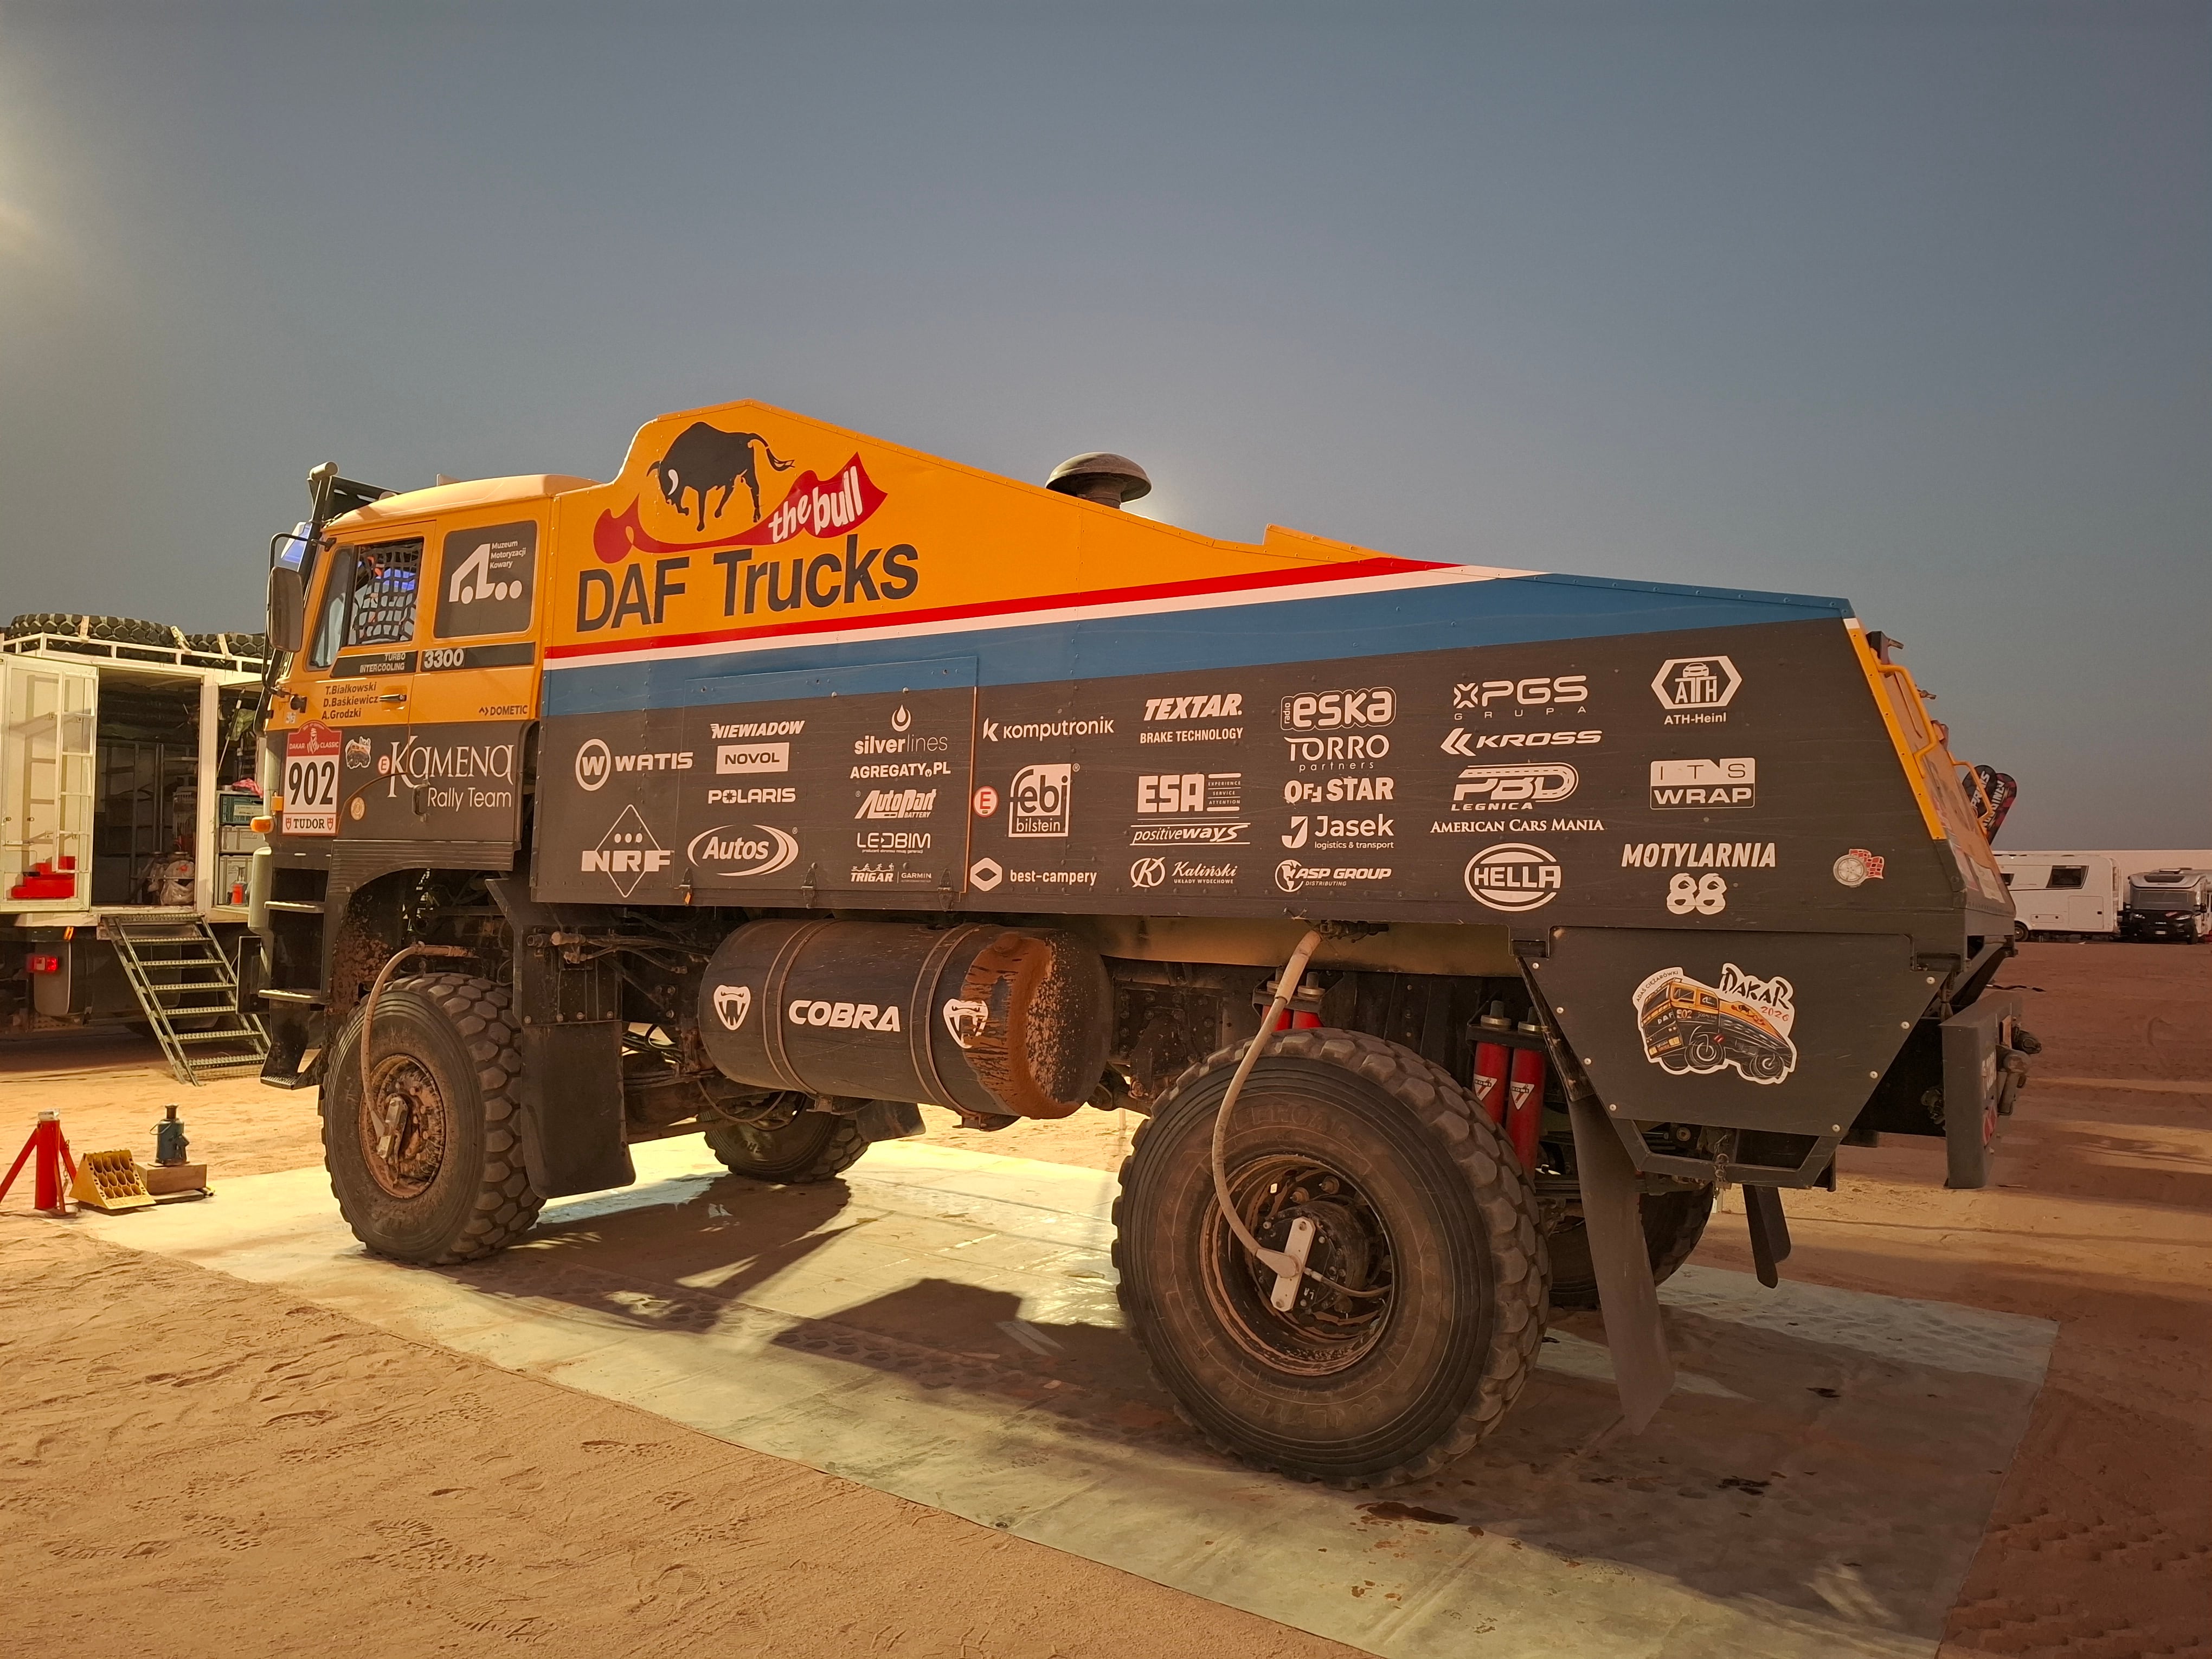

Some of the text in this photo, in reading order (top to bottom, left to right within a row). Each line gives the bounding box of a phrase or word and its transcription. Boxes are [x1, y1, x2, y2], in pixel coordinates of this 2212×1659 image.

[768, 466, 863, 543] the bull
[491, 548, 526, 559] Motoryzacji
[492, 541, 518, 550] Muzeum
[490, 560, 512, 569] Kowary
[576, 533, 918, 633] DAF Trucks
[384, 653, 406, 661] TURBO
[423, 649, 464, 668] 3300
[359, 663, 404, 673] INTERCOOLING
[325, 682, 376, 695] T.Białkowski
[1675, 676, 1717, 704] ATH
[321, 709, 361, 719] A.Grodzki
[490, 705, 528, 716] DOMETIC
[1454, 706, 1586, 720] GRUPA
[1664, 712, 1726, 725] ATH-Heinl
[1003, 716, 1114, 741] komputronik
[1140, 728, 1244, 744] BRAKE TECHNOLOGY
[854, 734, 948, 755] silverlines
[1284, 734, 1390, 761] TORRO
[1476, 730, 1603, 749] KROSS
[615, 752, 693, 771] WATIS
[725, 752, 780, 764] NOVOL
[850, 762, 951, 779] AGREGATY.PL
[1299, 761, 1374, 773] partners
[1660, 763, 1745, 780] ITS
[288, 761, 335, 806] 902
[1326, 777, 1394, 802] STAR
[1453, 763, 1577, 801] PBD
[427, 787, 511, 812] Rally Team
[708, 788, 796, 803] POLARIS
[1009, 769, 1068, 814] febi
[1138, 774, 1205, 812] ESA
[1653, 787, 1752, 805] WRAP
[854, 789, 937, 819] AutoPart
[980, 792, 991, 809] E
[1451, 802, 1533, 811] LEGNICA
[294, 818, 325, 829] TUDOR
[1017, 817, 1060, 832] bilstein
[1315, 813, 1394, 837] Jasek
[857, 832, 931, 848] LEDBIM
[1133, 824, 1248, 843] positiveways
[702, 836, 769, 859] Autos
[1315, 841, 1347, 850] logistics
[1356, 841, 1394, 850] transport
[581, 850, 671, 872] NRF
[1621, 843, 1776, 867] MOTYLARNIA
[851, 872, 893, 882] TRIGAR
[1011, 869, 1097, 886] best-campery
[1172, 861, 1238, 877] Kaliński
[1333, 868, 1392, 879] GROUP
[1474, 865, 1561, 889] HELLA
[1667, 872, 1727, 915] 88
[1722, 967, 1789, 1010] DAKAR
[788, 999, 901, 1032] COBRA
[1657, 1012, 1674, 1025] DAF
[1676, 1009, 1692, 1019] 902
[1760, 1006, 1790, 1021] 2026
